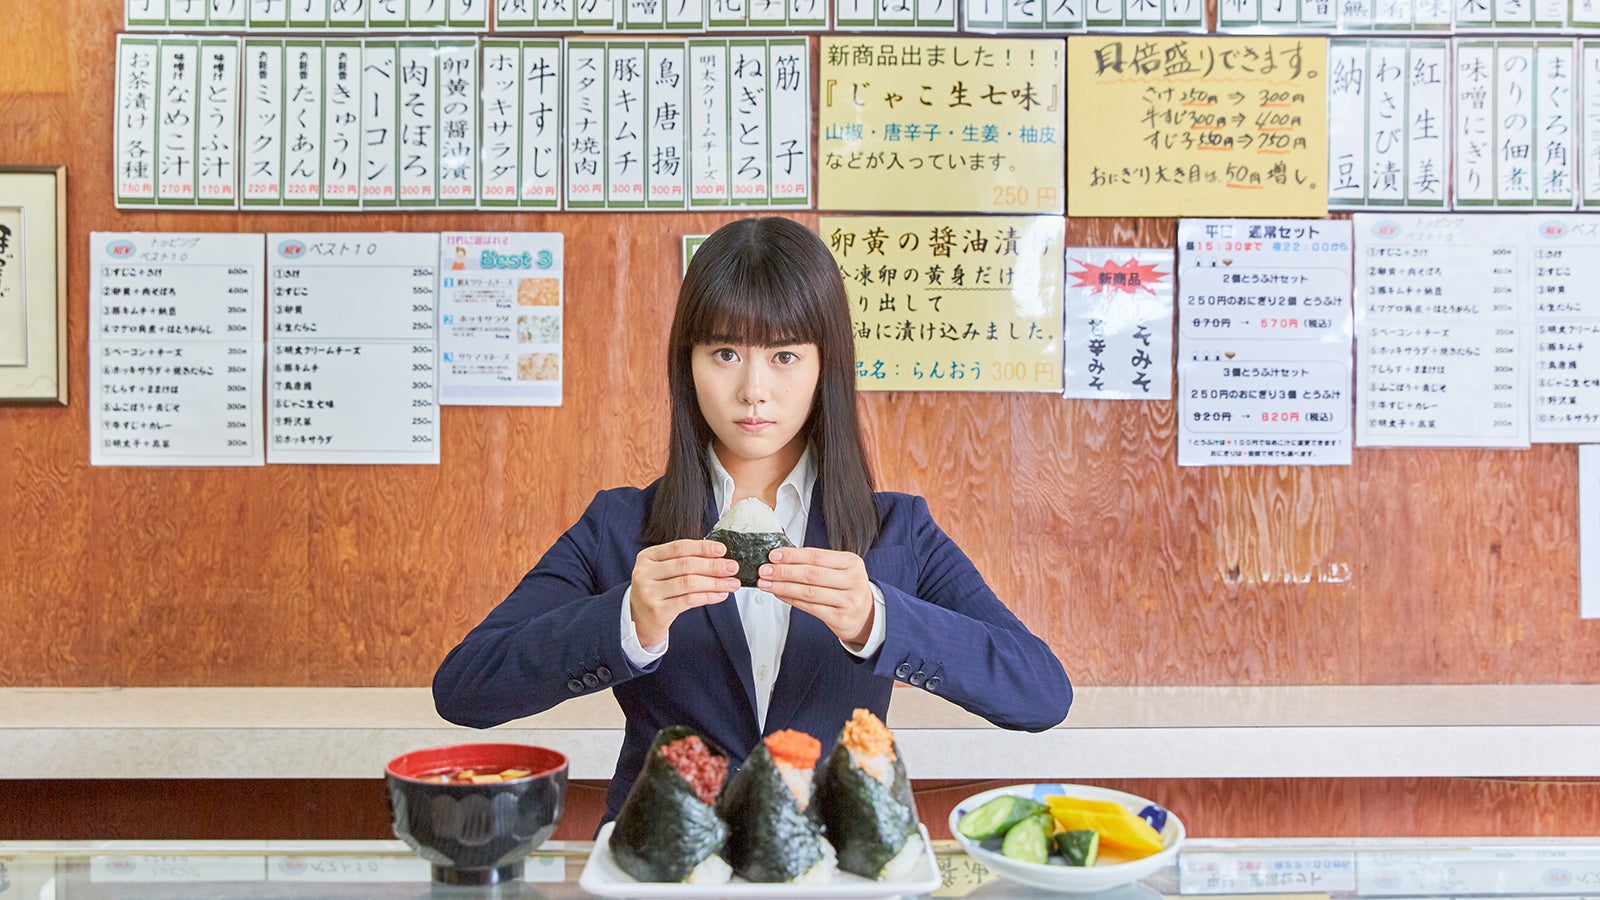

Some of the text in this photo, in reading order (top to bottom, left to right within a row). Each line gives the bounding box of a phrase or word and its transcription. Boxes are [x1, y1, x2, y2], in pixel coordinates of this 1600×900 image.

[828, 44, 1057, 67] 新商品出ました！！！
[827, 79, 1056, 111] 『じゃこ生七味』
[162, 85, 189, 176] なめこ汁
[255, 85, 275, 176] ミックス
[291, 84, 314, 177] たくあん
[333, 84, 356, 177] きゅうり
[364, 60, 391, 180] ベーコン
[403, 60, 431, 176] 肉そぼろ
[443, 58, 470, 180] 卵黄の醤油漬
[490, 55, 515, 178] ホッキサラダ
[528, 57, 557, 179] 牛すじ
[572, 58, 600, 175] スタミナ焼肉
[614, 57, 639, 173] 豚キムチ
[653, 58, 680, 176] 鳥唐揚
[700, 55, 717, 179] 明太クリームチーズ
[734, 54, 763, 179] ねぎとろ
[776, 55, 804, 175] 筋子
[1333, 57, 1364, 193] 納豆
[1373, 58, 1401, 191] わさび漬
[1413, 58, 1443, 195] 紅生姜
[1461, 58, 1487, 190] 味噌にぎり
[1502, 57, 1529, 191] のりの佃煮
[1545, 57, 1572, 193] まぐろ角煮
[202, 86, 229, 178] とうふ汁
[826, 123, 1056, 143] 山椒・唐辛子・生姜・柚皮
[826, 151, 1015, 171] などが入っています。
[161, 183, 192, 194] 270円
[202, 184, 233, 195] 170円
[362, 185, 393, 196] 300円
[399, 185, 429, 196] 300円
[440, 185, 472, 196] 300円
[484, 185, 515, 196] 300円
[525, 185, 555, 196] 300円
[570, 183, 602, 195] 300円
[612, 184, 642, 195] 300円
[651, 184, 682, 196] 300円
[694, 184, 725, 195] 300円
[734, 184, 765, 195] 300円
[774, 183, 805, 195] 550円
[994, 186, 1058, 206] 250円
[829, 226, 1052, 258] 卵黄の醤油漬
[1248, 223, 1321, 240] 通常セット
[309, 243, 379, 257] ベスト10
[480, 249, 553, 270] Best 3
[859, 293, 942, 312] り出して
[854, 320, 1054, 341] 油に漬け込みました。
[855, 359, 981, 381] 品名：らんおう
[1131, 324, 1153, 393] そみそ
